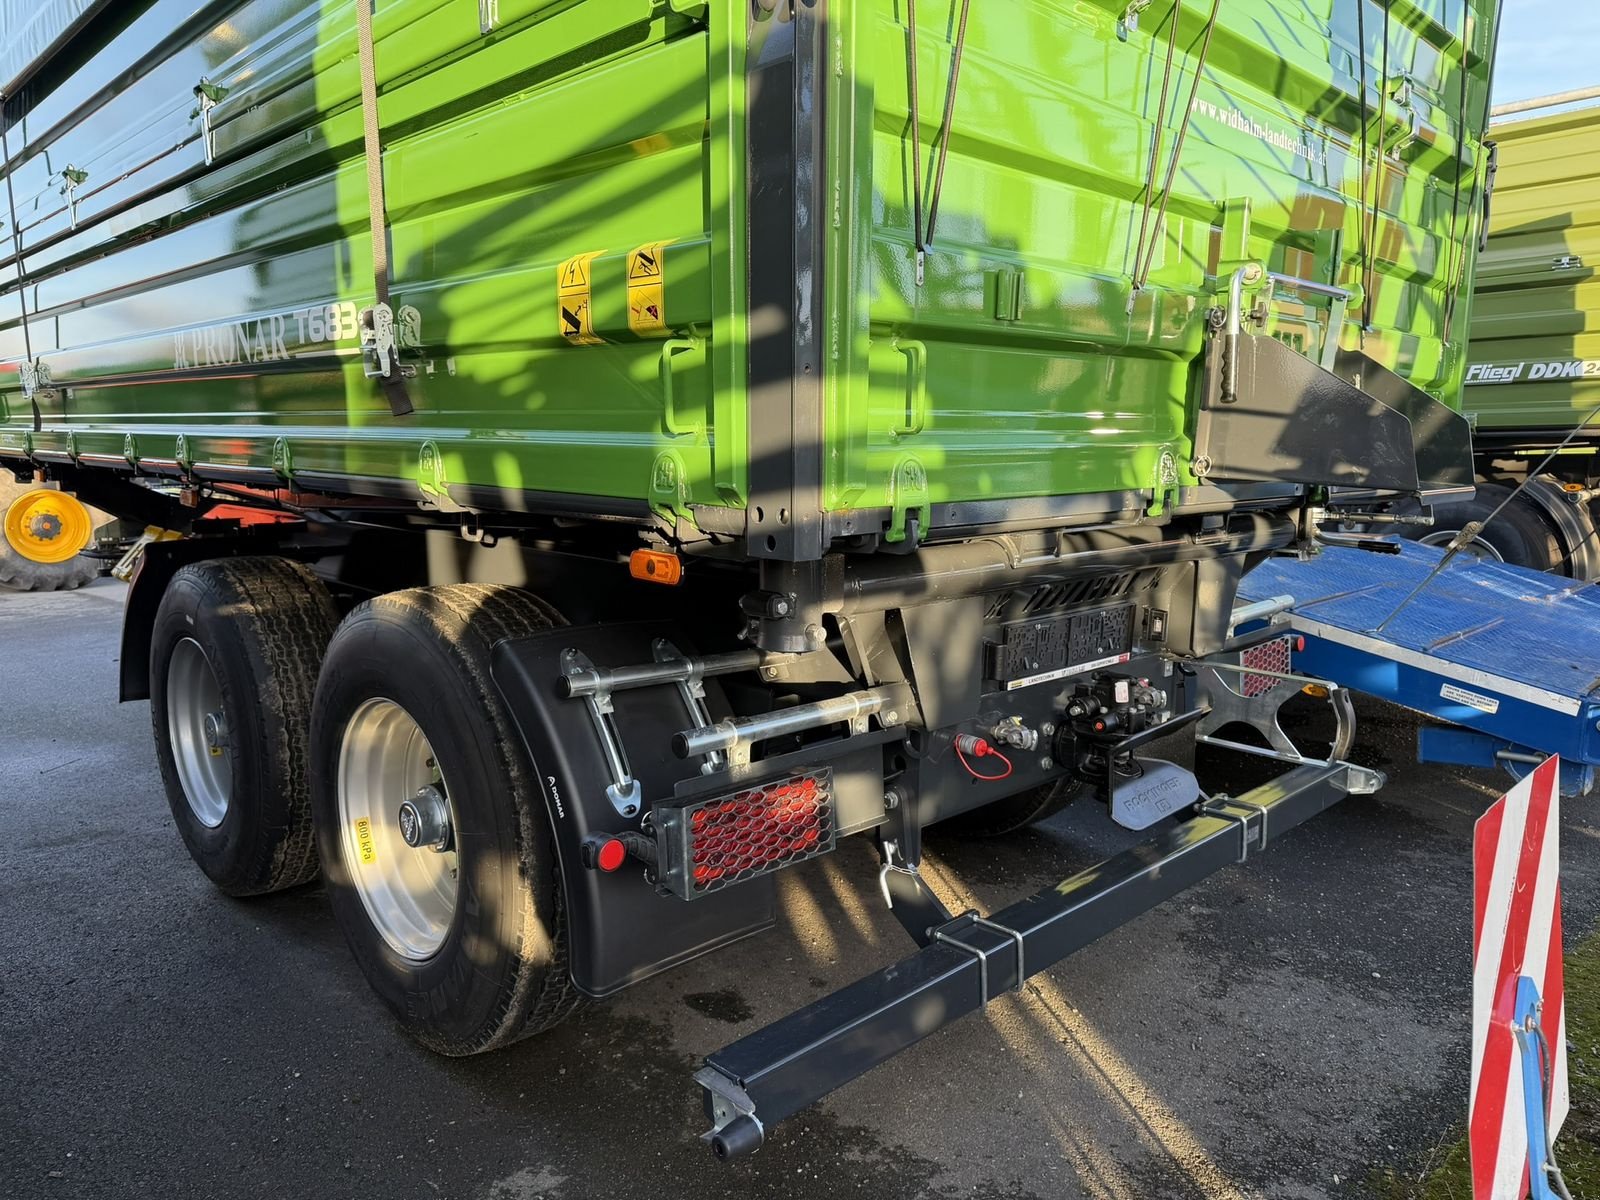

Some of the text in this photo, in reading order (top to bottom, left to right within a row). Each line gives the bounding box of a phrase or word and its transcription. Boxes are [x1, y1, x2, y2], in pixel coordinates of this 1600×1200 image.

[191, 302, 358, 368] PRONAR T683
[1465, 362, 1525, 383] Fliegl
[1528, 361, 1582, 379] DDK
[551, 785, 565, 819] DOMAR
[357, 820, 372, 860] 800 kPa
